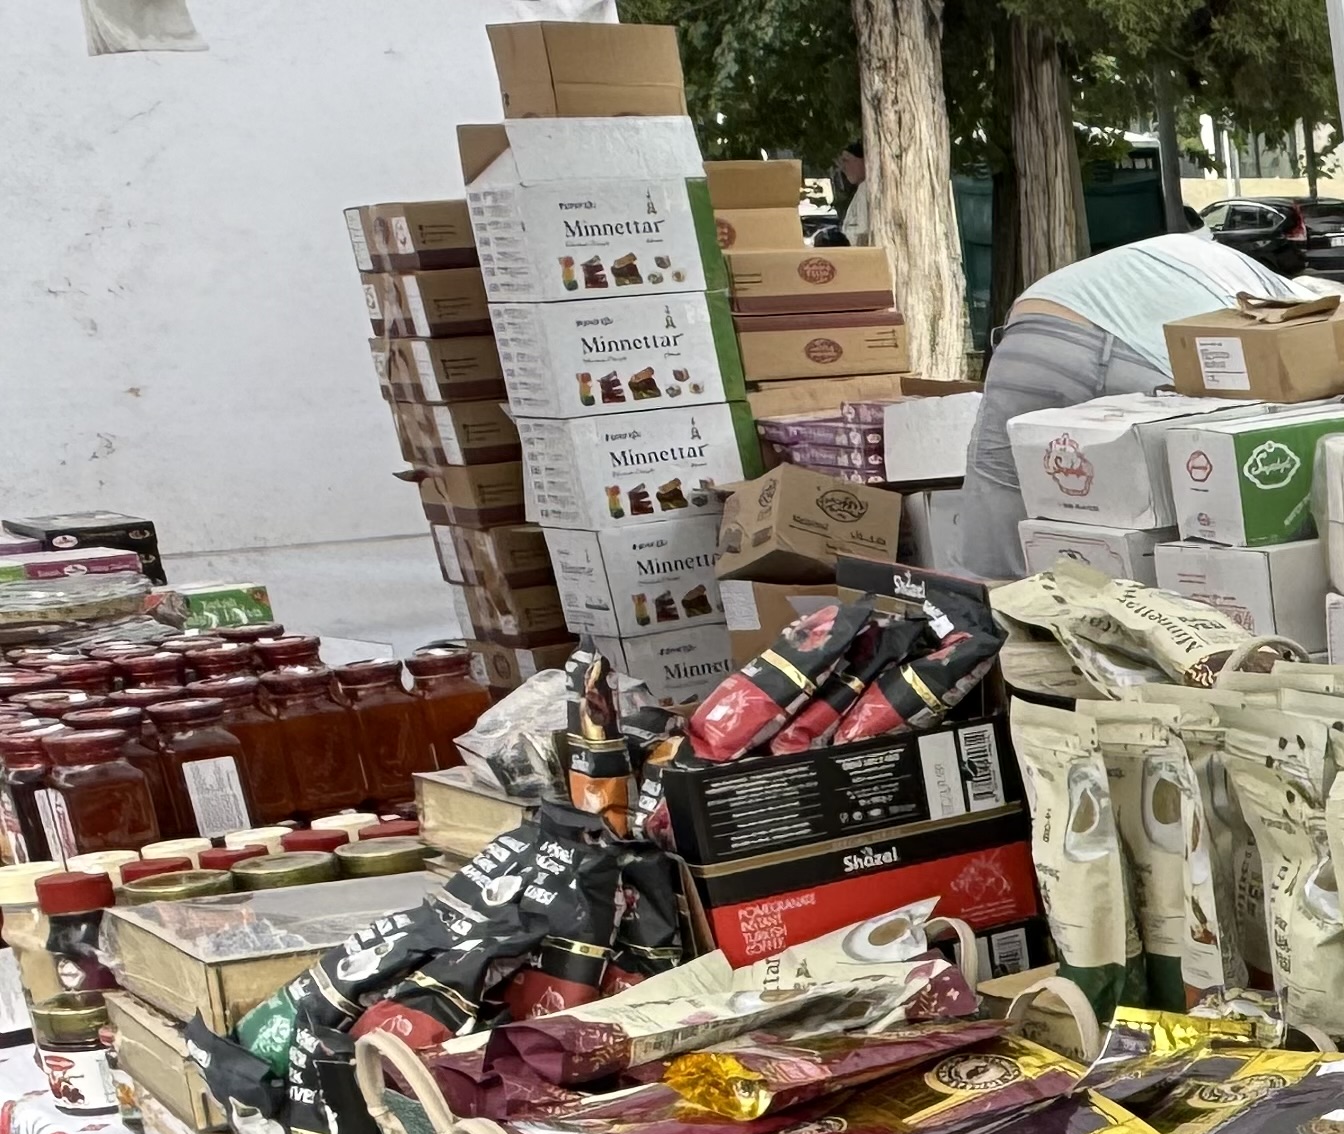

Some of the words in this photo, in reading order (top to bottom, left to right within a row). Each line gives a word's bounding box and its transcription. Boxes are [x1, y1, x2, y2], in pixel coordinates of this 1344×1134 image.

[564, 219, 665, 238] Minnettar
[581, 333, 684, 355] Minnettar
[609, 443, 709, 467] Minnettar
[664, 658, 730, 681] Minnet
[843, 846, 899, 872] Shazel
